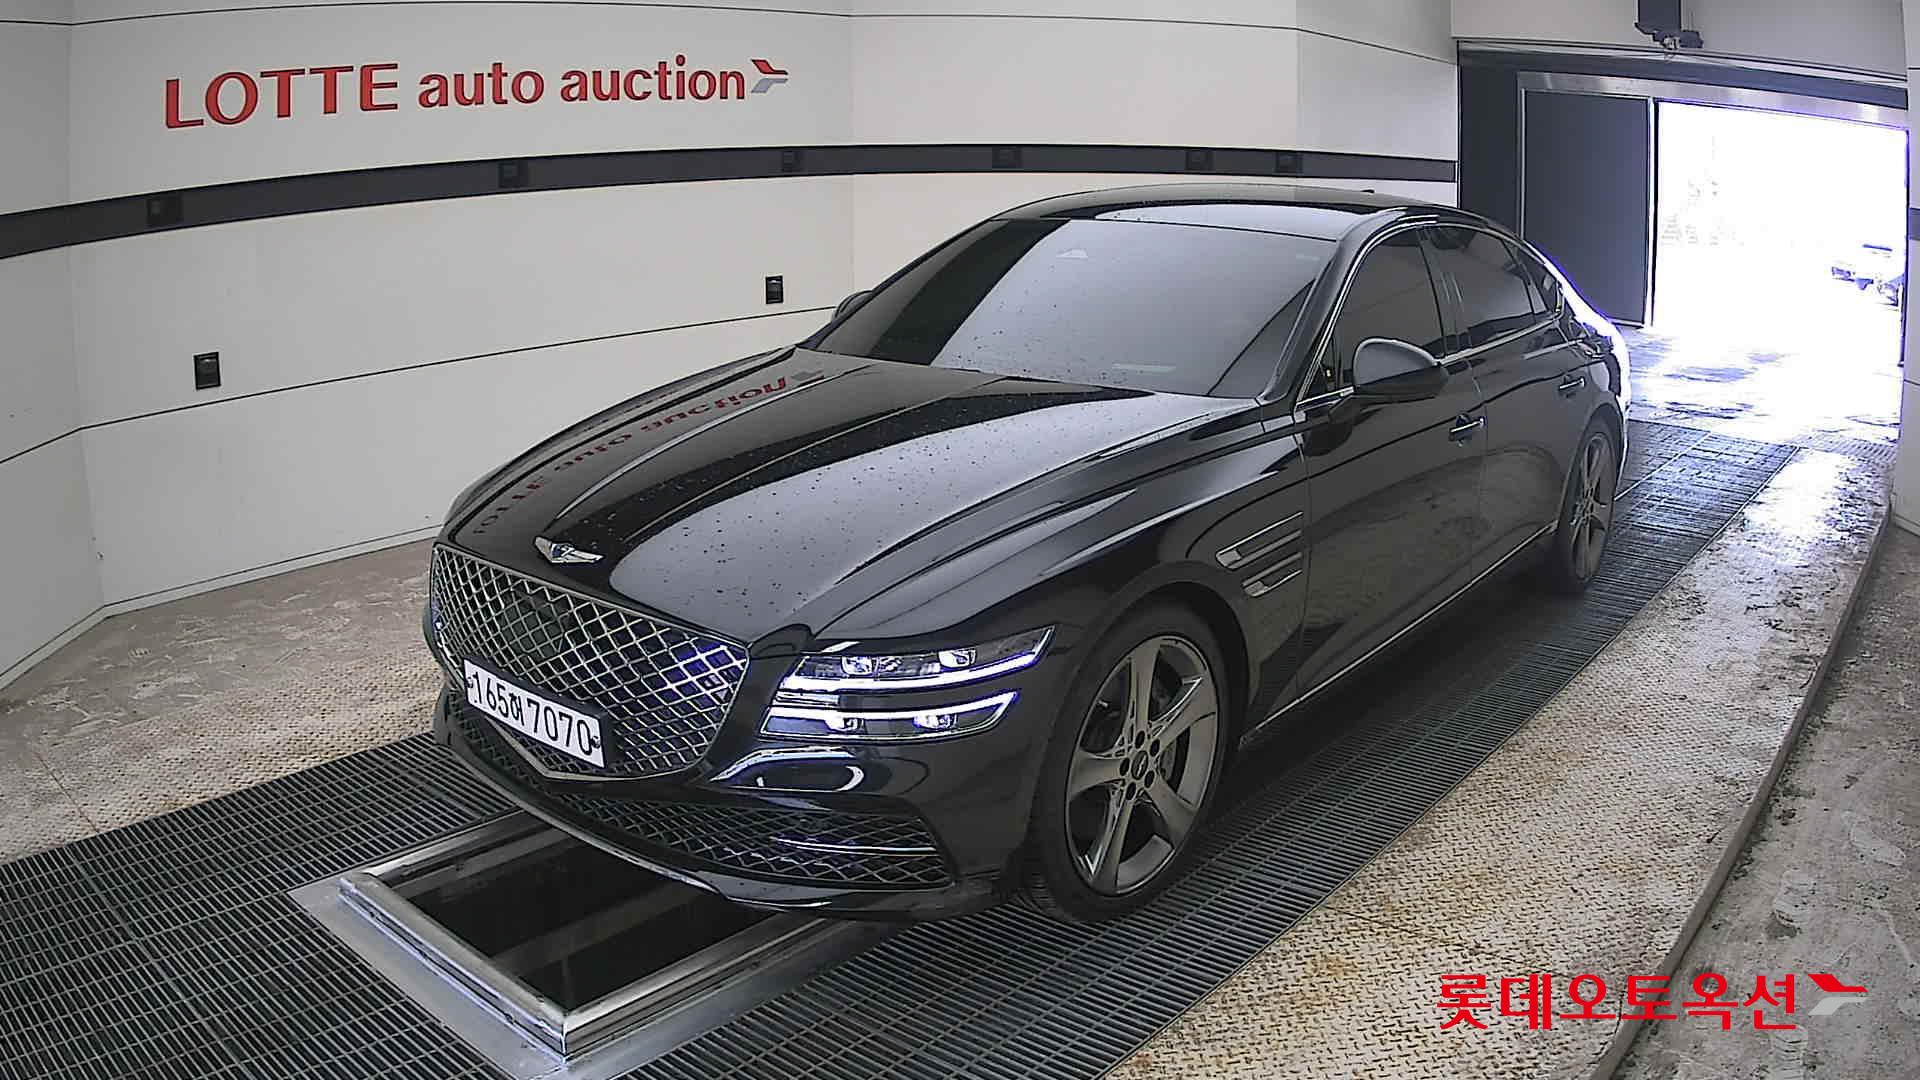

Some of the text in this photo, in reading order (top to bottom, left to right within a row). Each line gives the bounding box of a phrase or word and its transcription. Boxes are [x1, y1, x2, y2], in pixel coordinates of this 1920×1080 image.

[165, 54, 745, 129] LOTTE auto auction
